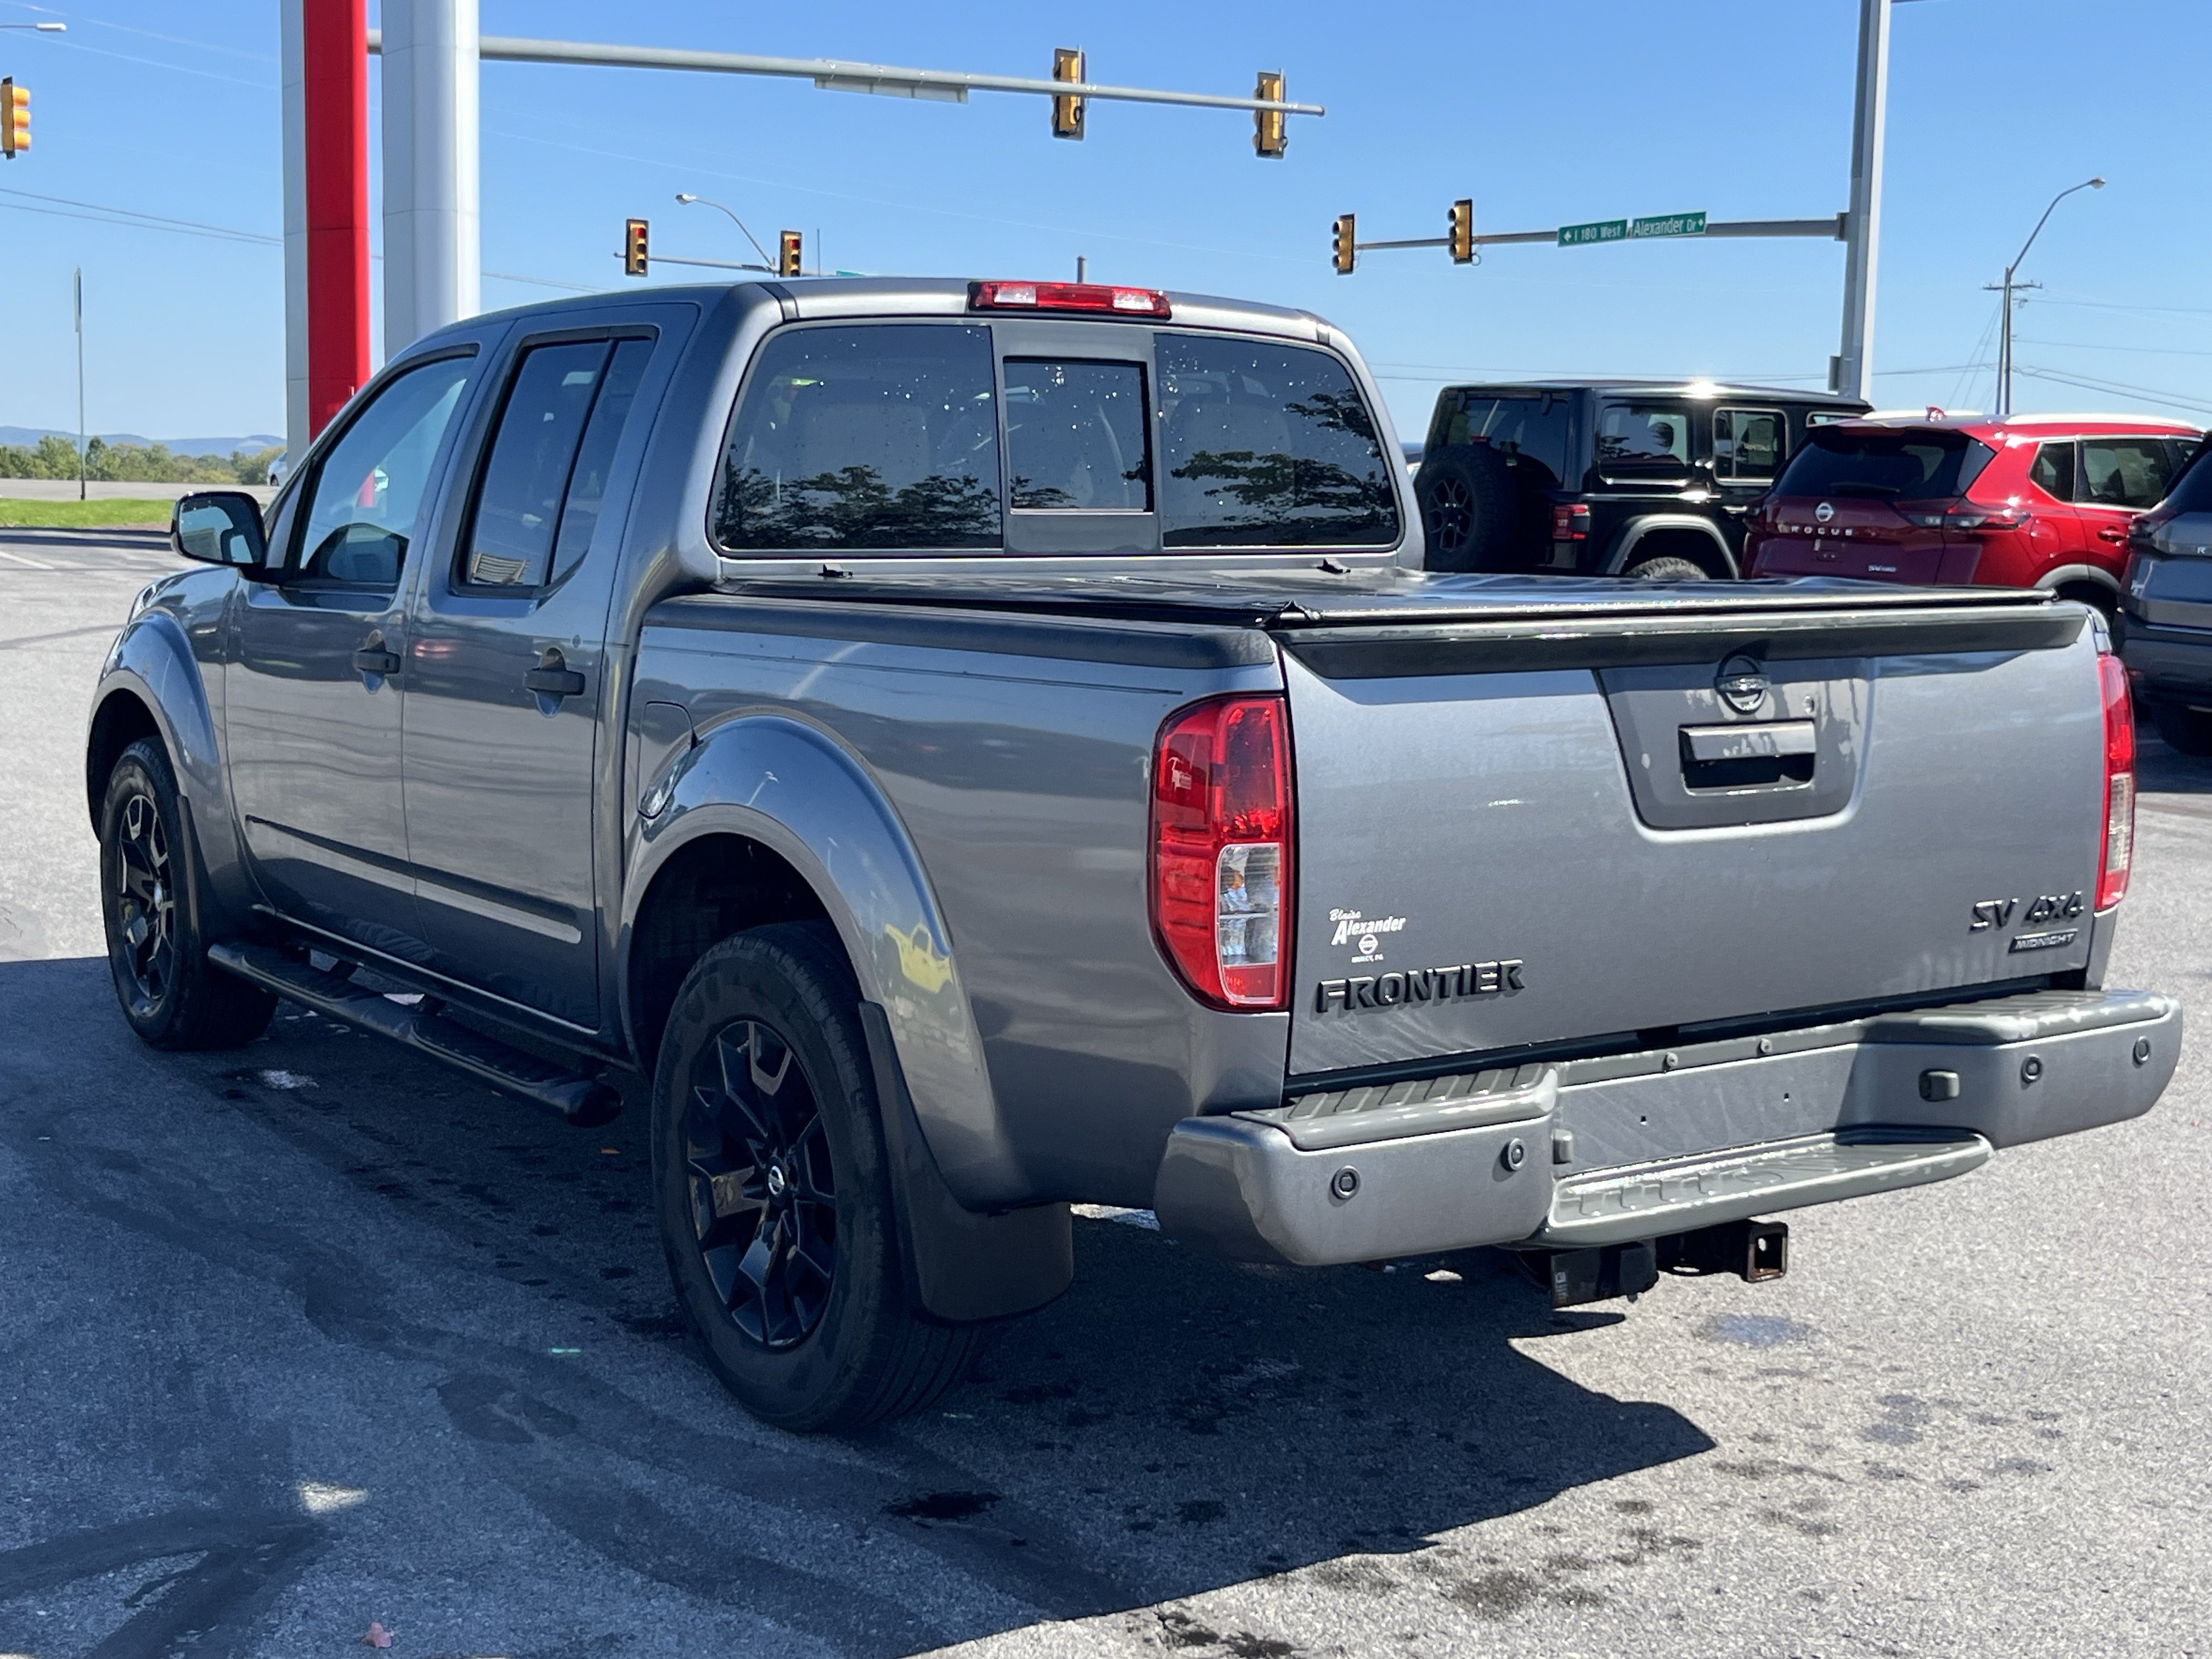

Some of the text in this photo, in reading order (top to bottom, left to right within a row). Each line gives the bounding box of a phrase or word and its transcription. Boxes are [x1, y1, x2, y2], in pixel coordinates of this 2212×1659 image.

[1581, 227, 1597, 241] 180
[1600, 225, 1621, 238] West
[1634, 218, 1697, 236] Alexander Dr
[1791, 526, 1853, 536] ROGUE
[1970, 898, 2018, 931] SV
[1331, 916, 1406, 945] Alexander
[2015, 933, 2074, 950] MIDNIGHT
[1316, 958, 1525, 1013] FRONTIER
